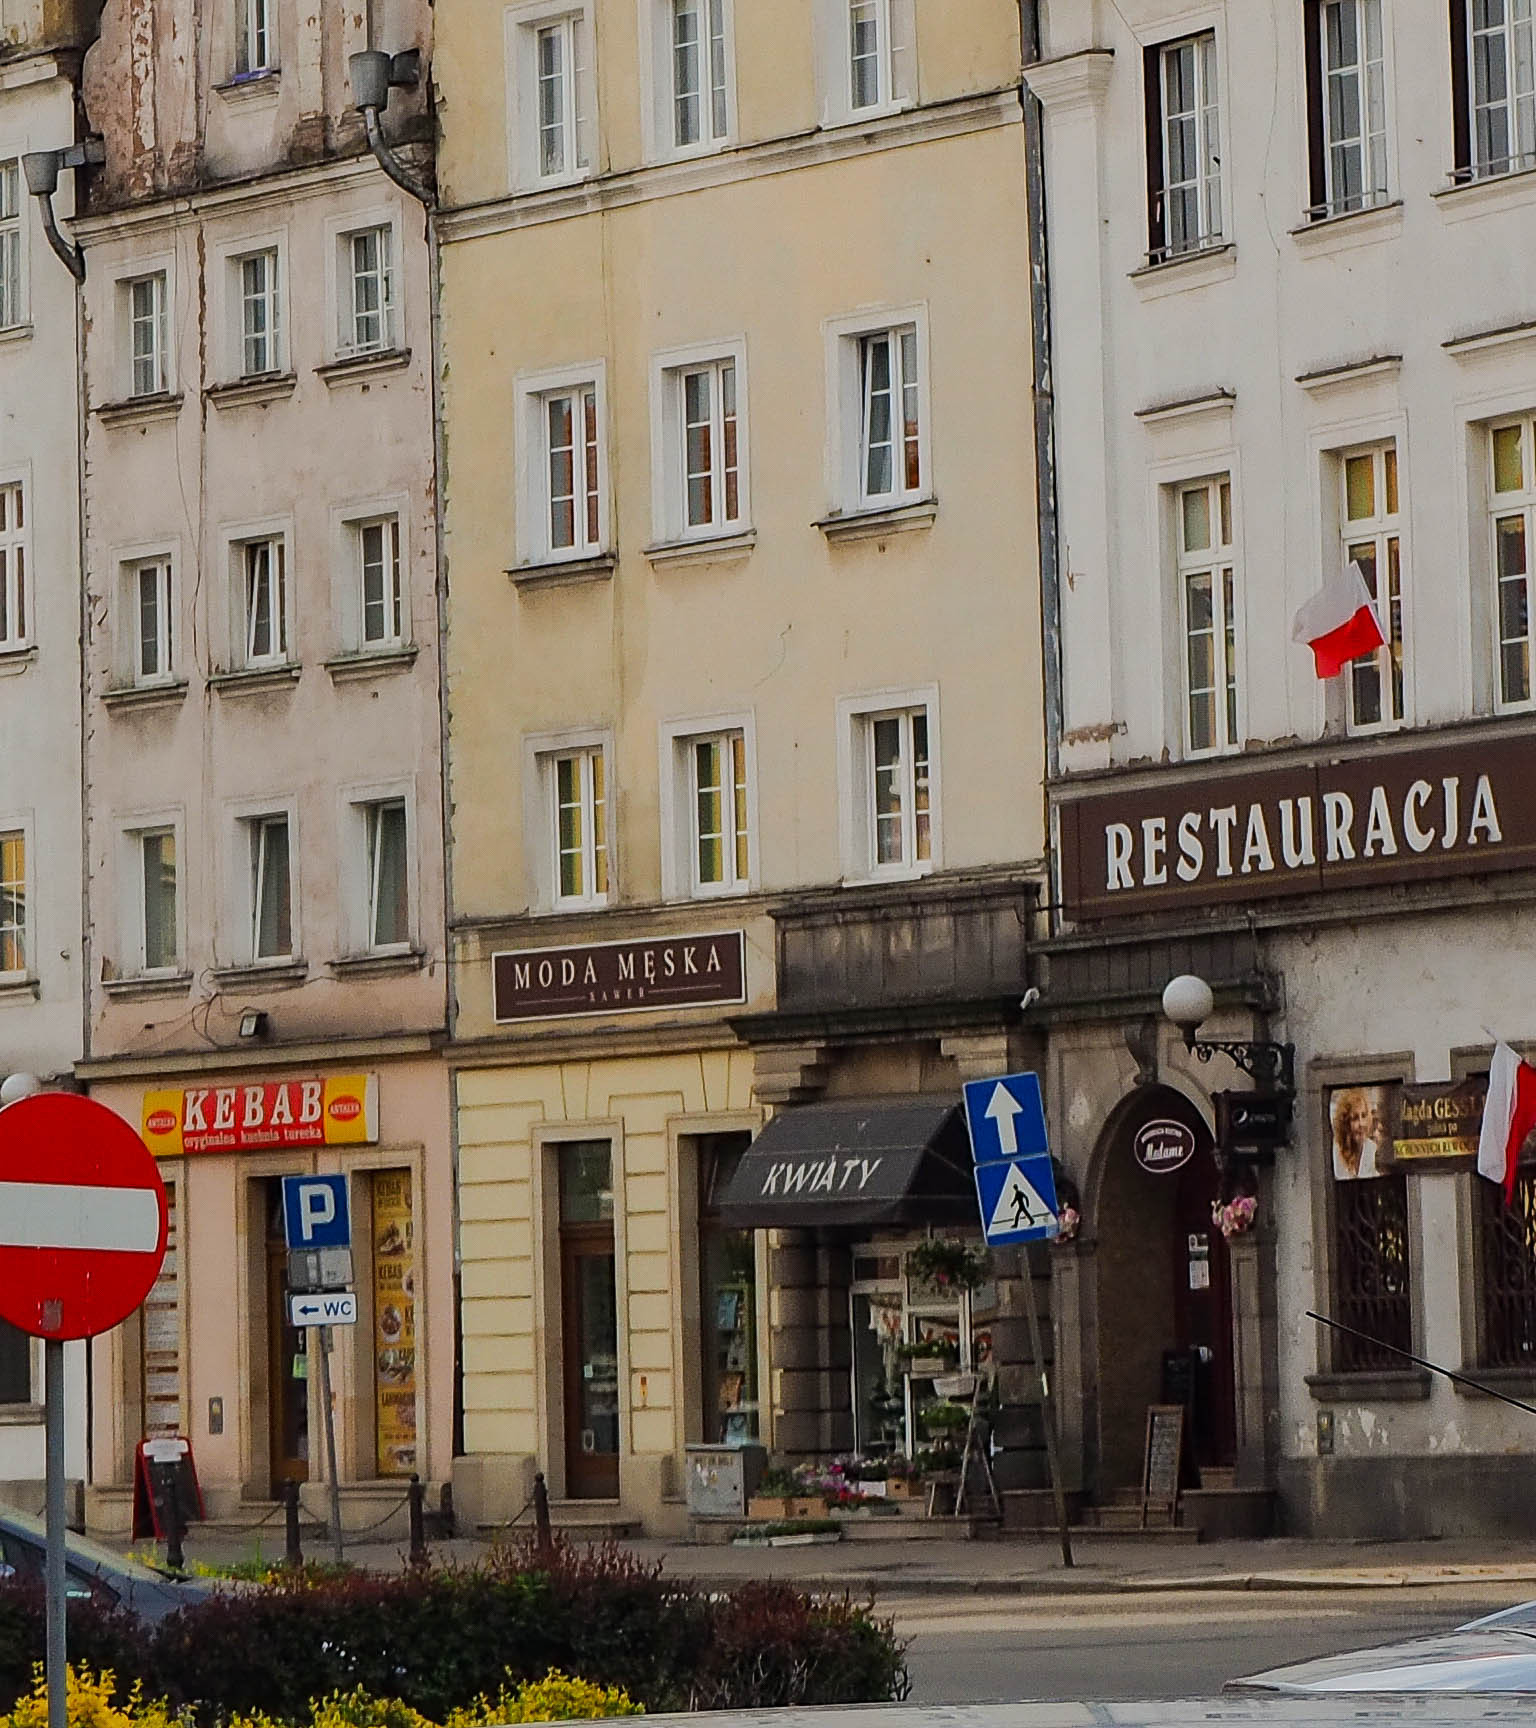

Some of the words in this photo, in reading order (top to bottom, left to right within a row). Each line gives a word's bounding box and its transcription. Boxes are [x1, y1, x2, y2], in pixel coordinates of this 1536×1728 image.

[1105, 775, 1502, 890] RESTAURACJA
[514, 956, 598, 990] MODA
[618, 944, 722, 984] MĘSKA
[183, 1081, 322, 1132] KEBAB
[761, 1157, 882, 1195] KWIATY
[298, 1184, 336, 1241] P
[323, 1301, 353, 1317] WC
